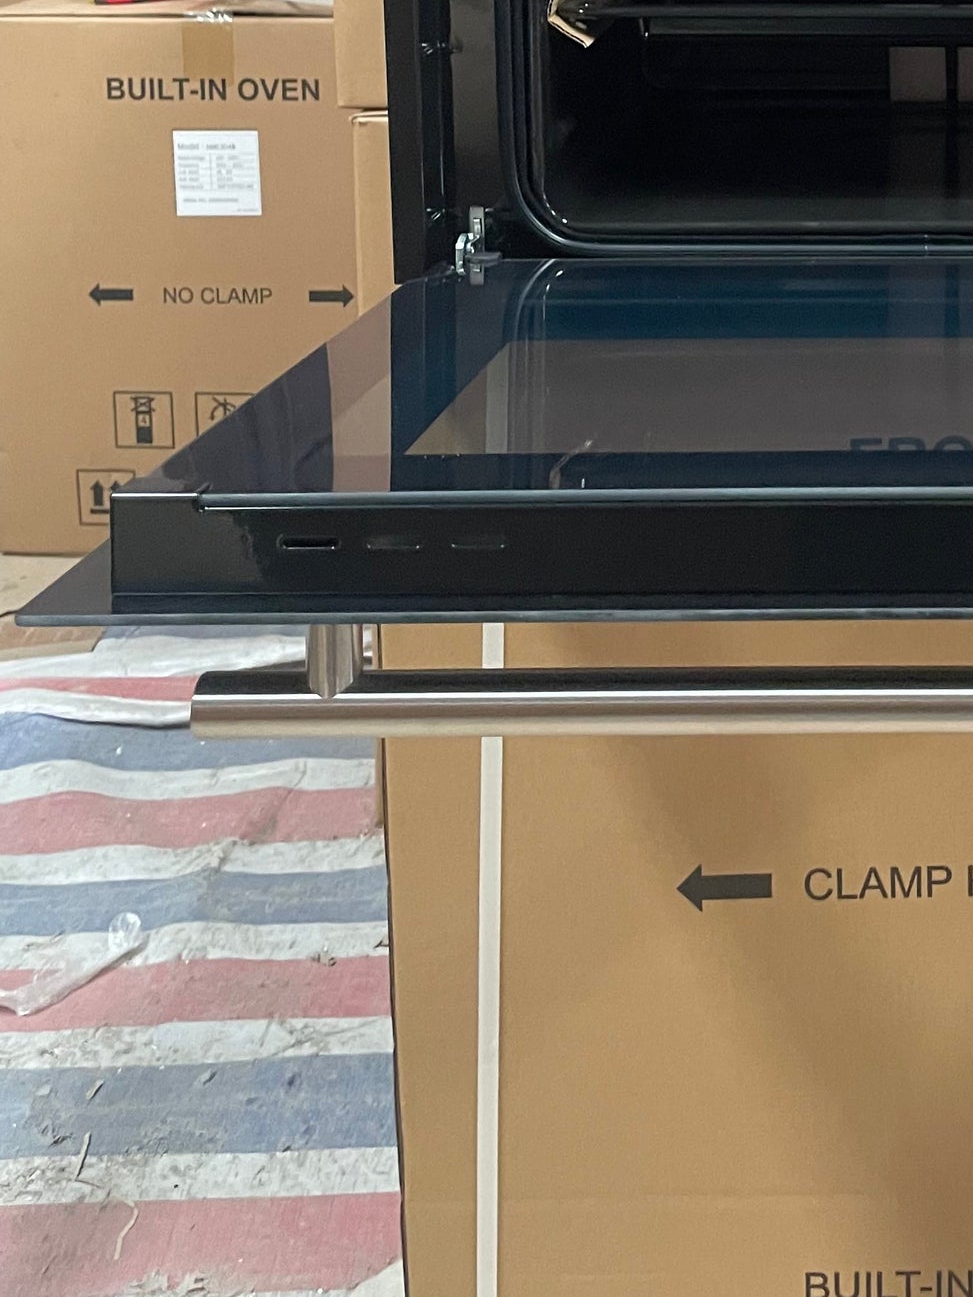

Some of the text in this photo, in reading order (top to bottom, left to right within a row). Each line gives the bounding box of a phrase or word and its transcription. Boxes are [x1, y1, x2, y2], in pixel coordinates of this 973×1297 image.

[106, 78, 320, 101] BUILT-IN OVEN
[163, 287, 273, 304] NO CLAMP
[803, 865, 953, 901] CLAMP
[804, 1268, 973, 1297] BUILT-IN
